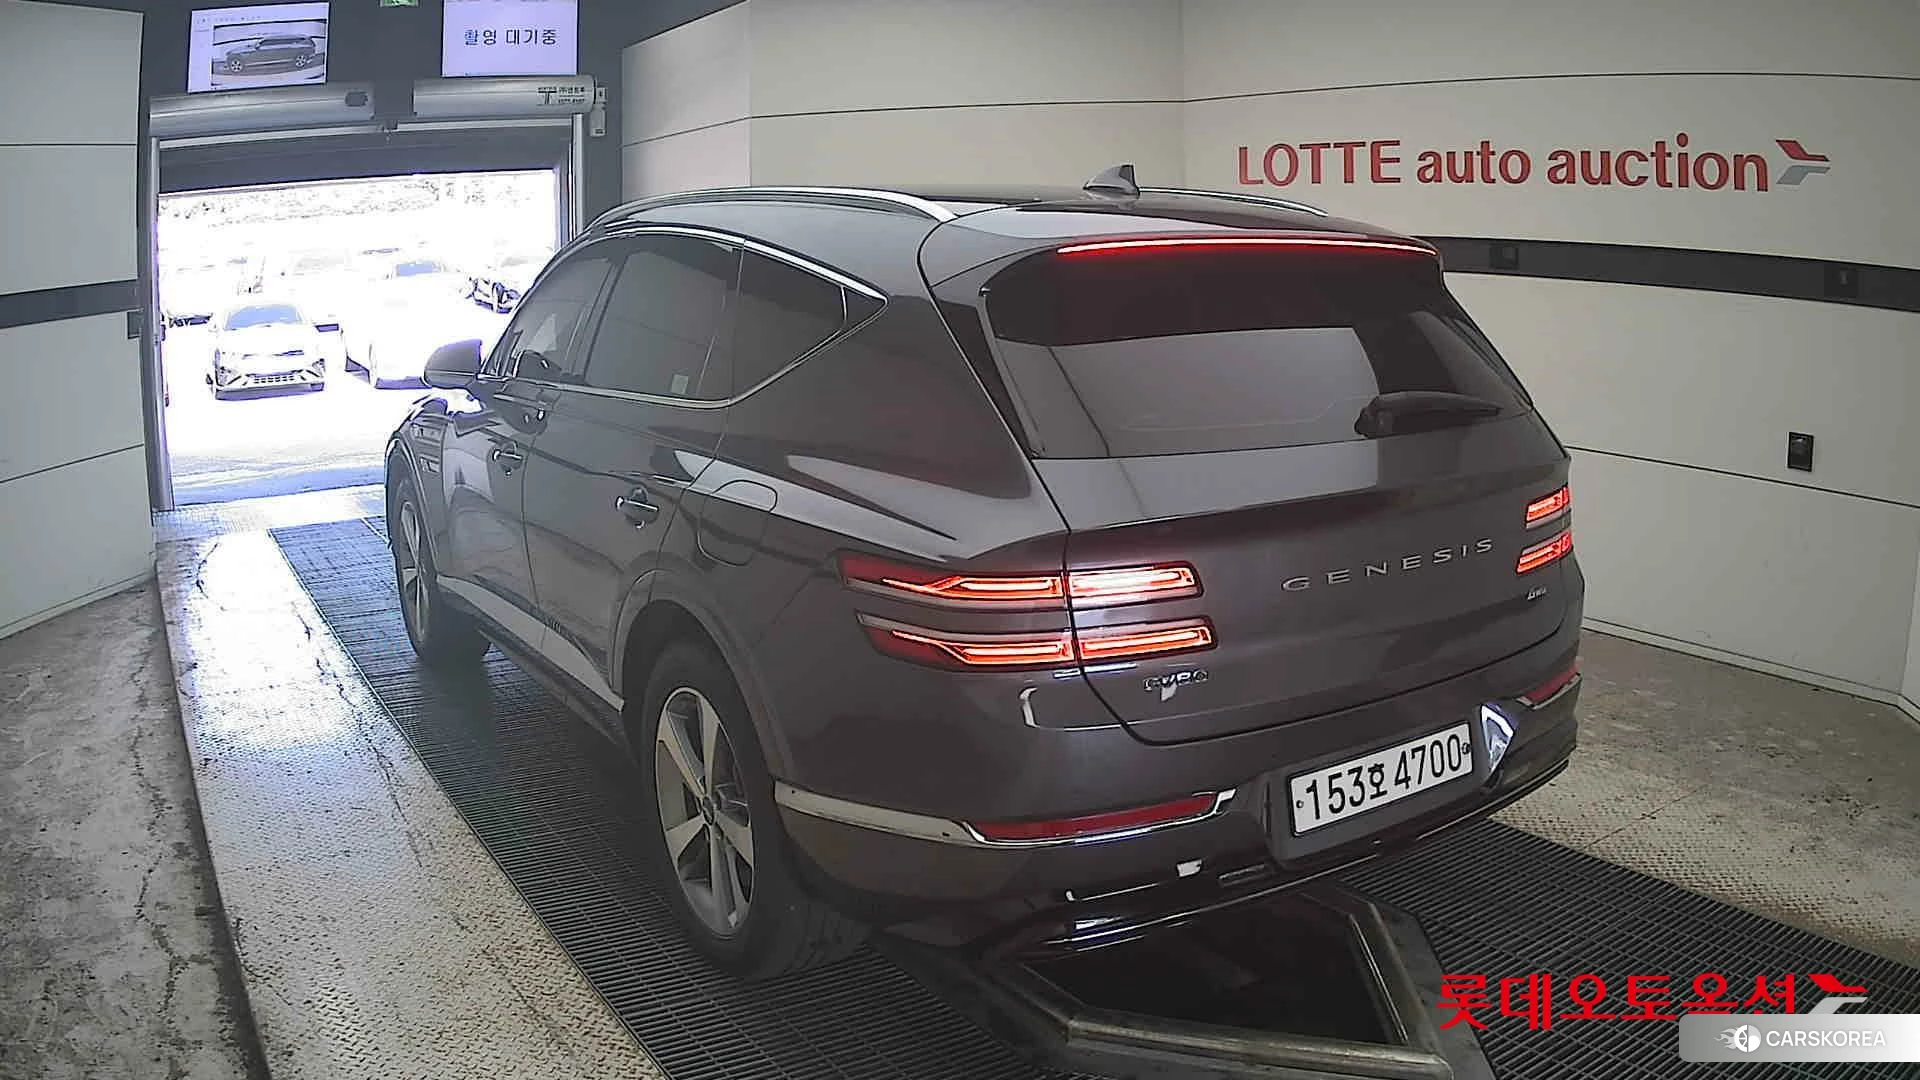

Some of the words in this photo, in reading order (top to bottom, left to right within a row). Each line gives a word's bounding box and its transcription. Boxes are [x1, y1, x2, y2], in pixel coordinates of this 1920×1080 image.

[505, 29, 557, 46] 대기중
[1238, 140, 1401, 187] LOTTE
[1416, 140, 1531, 184] auto
[1547, 132, 1768, 192] auction
[1282, 538, 1493, 591] GENESIS
[1306, 763, 1388, 820] 153호
[1394, 734, 1462, 789] 4700
